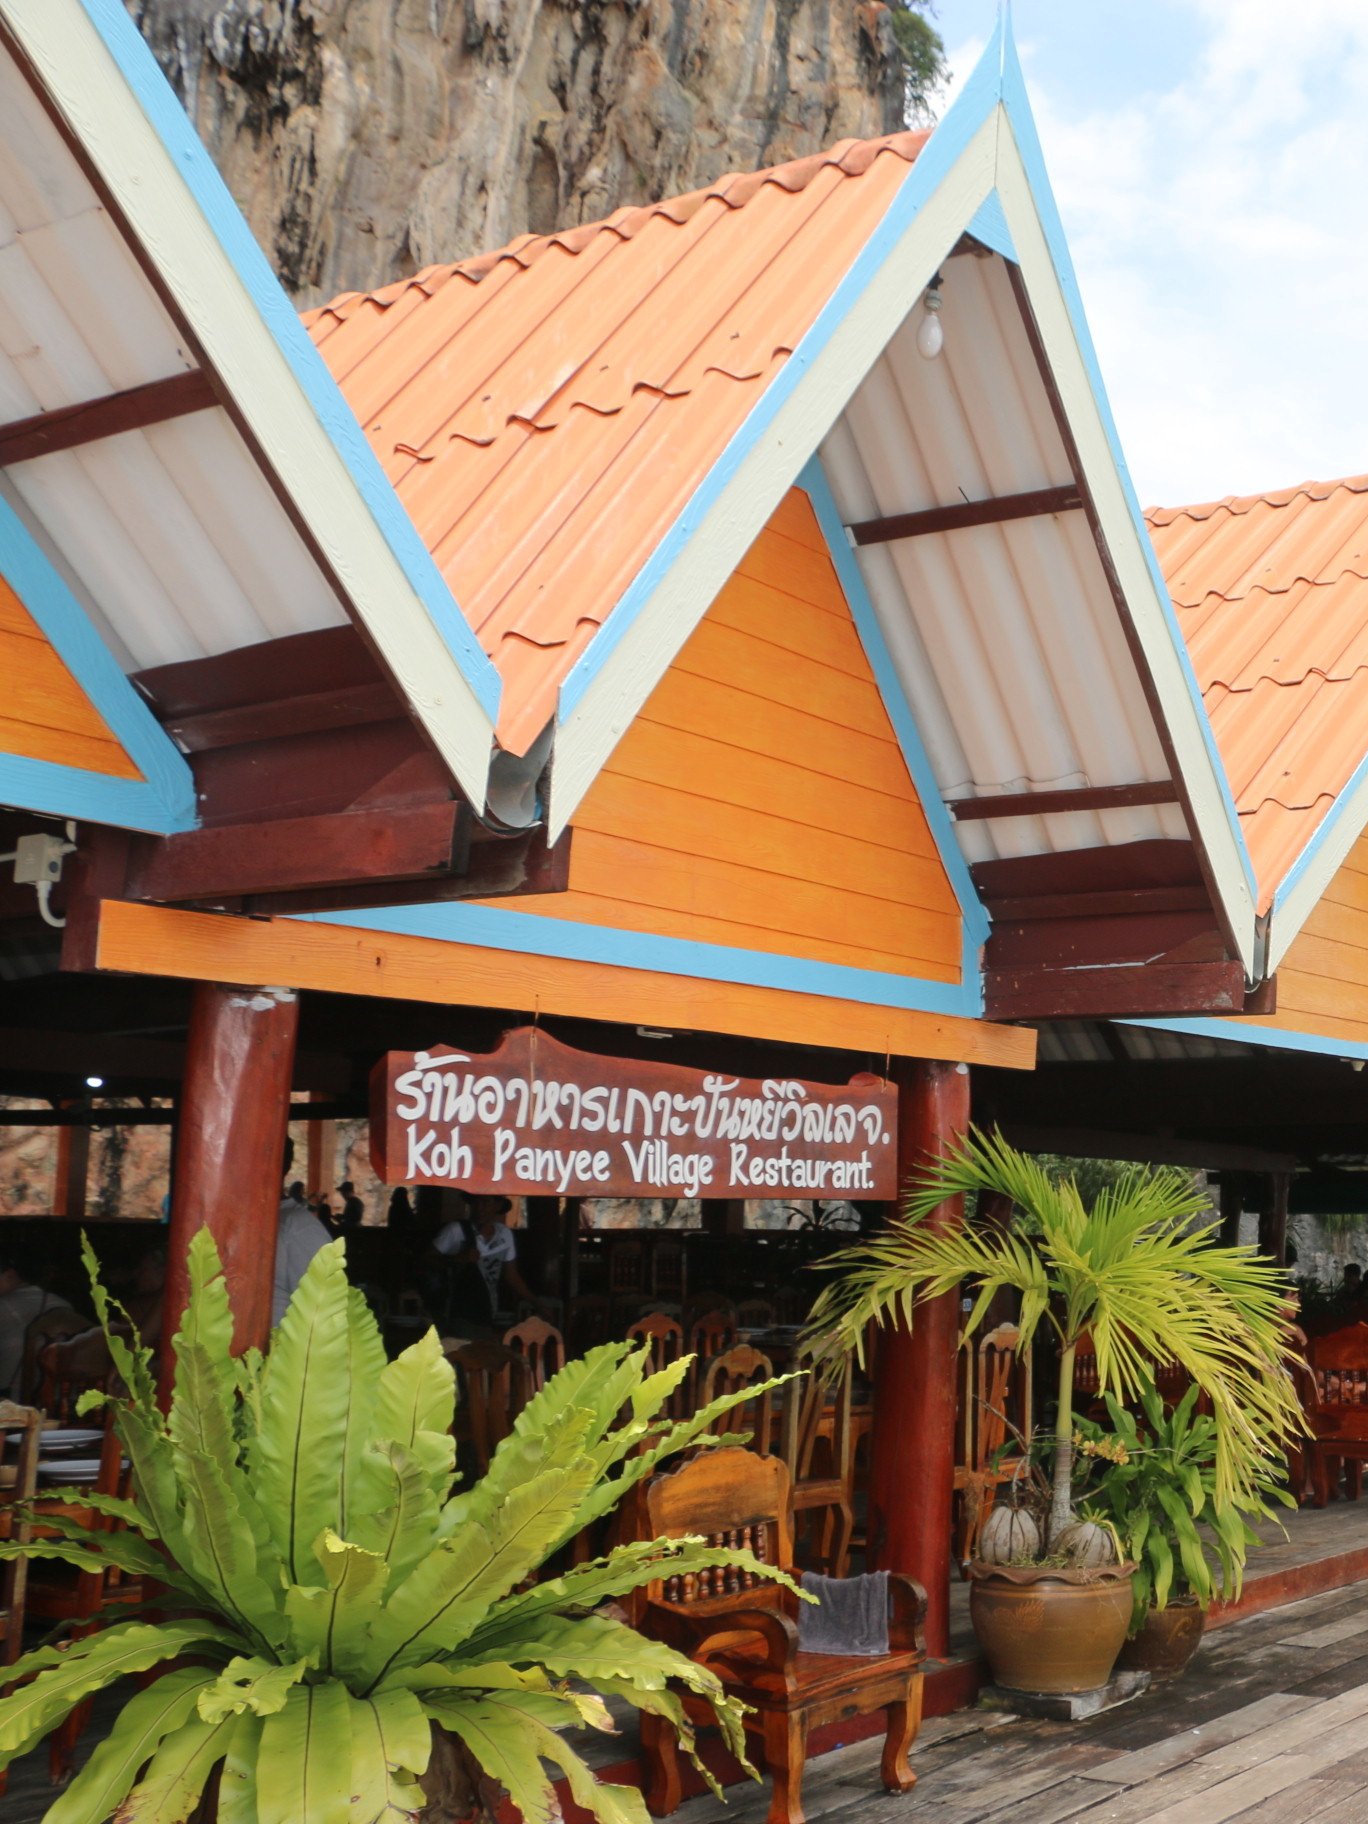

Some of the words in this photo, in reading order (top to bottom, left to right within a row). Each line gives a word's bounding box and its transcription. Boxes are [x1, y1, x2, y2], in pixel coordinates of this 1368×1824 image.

[405, 1122, 473, 1180] Koh
[491, 1126, 611, 1193] Panyee
[621, 1138, 714, 1198] Village
[728, 1141, 875, 1190] Restaurant.
